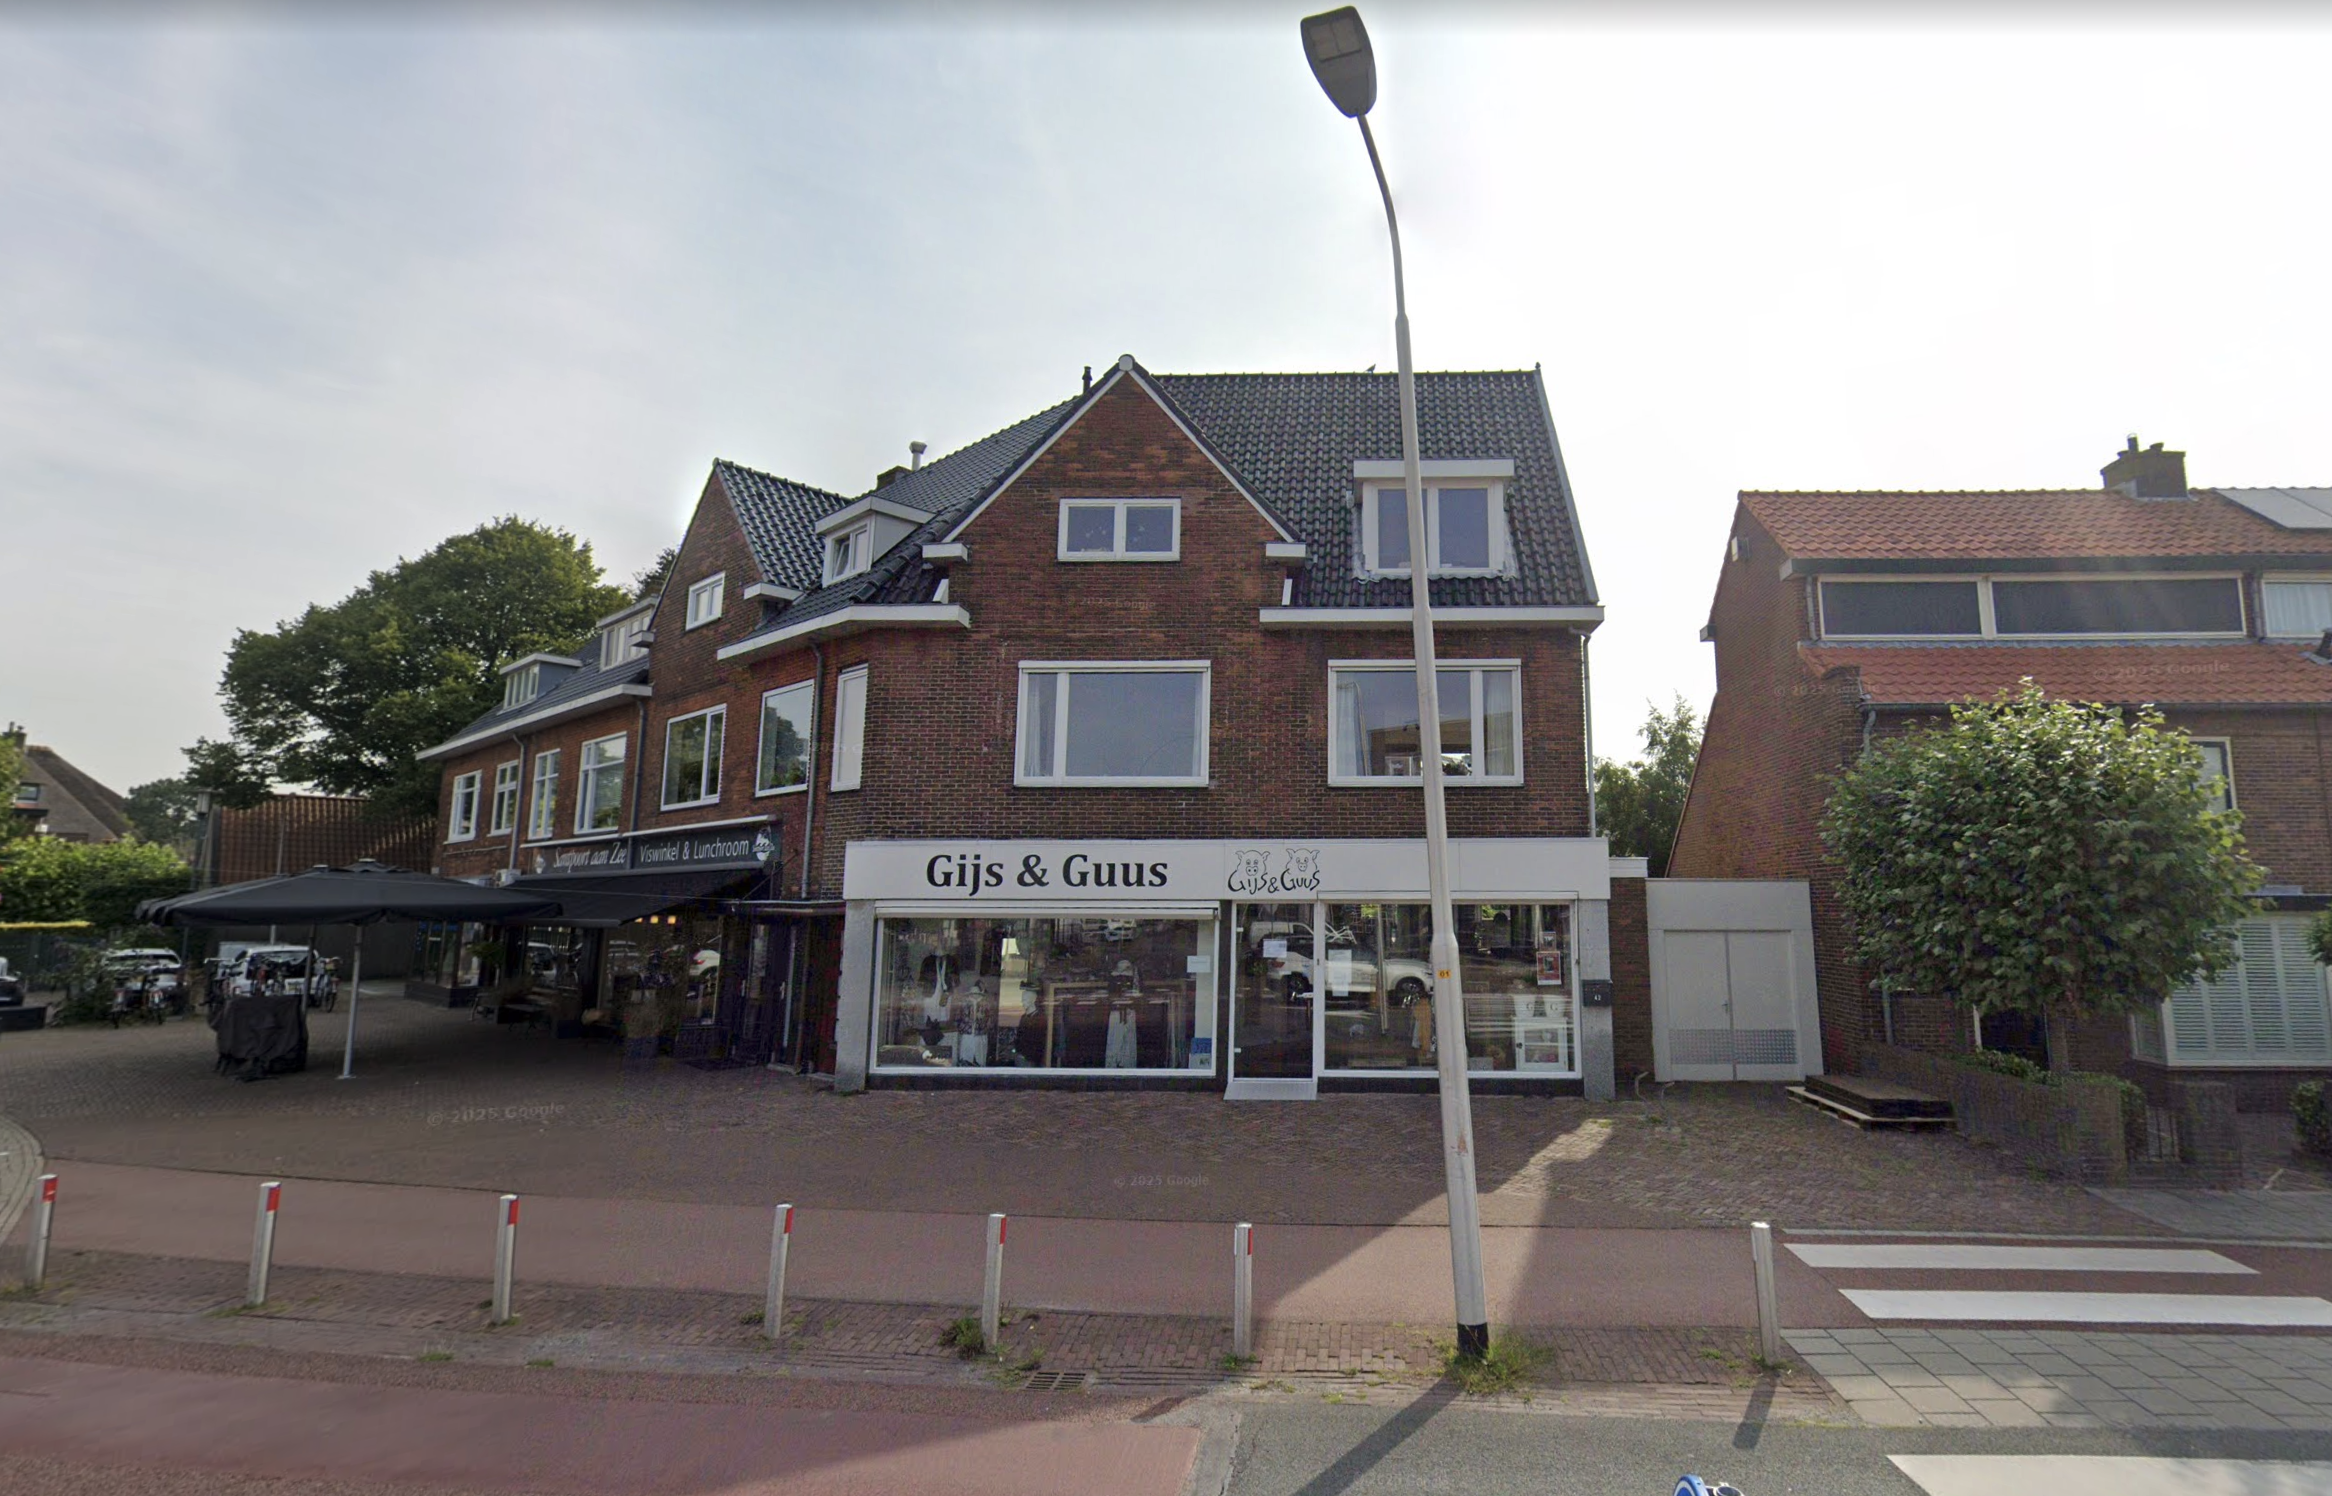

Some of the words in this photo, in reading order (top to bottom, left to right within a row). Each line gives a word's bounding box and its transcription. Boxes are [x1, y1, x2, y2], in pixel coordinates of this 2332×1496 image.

[590, 849, 609, 866] aan
[609, 841, 627, 864] Zee
[640, 840, 680, 863] Viswinkel
[682, 841, 690, 860] &
[693, 837, 750, 860] Lunchroom
[926, 853, 1004, 897] Gijs
[1016, 853, 1050, 888] &
[1062, 853, 1169, 888] Guus
[1267, 876, 1280, 894] &
